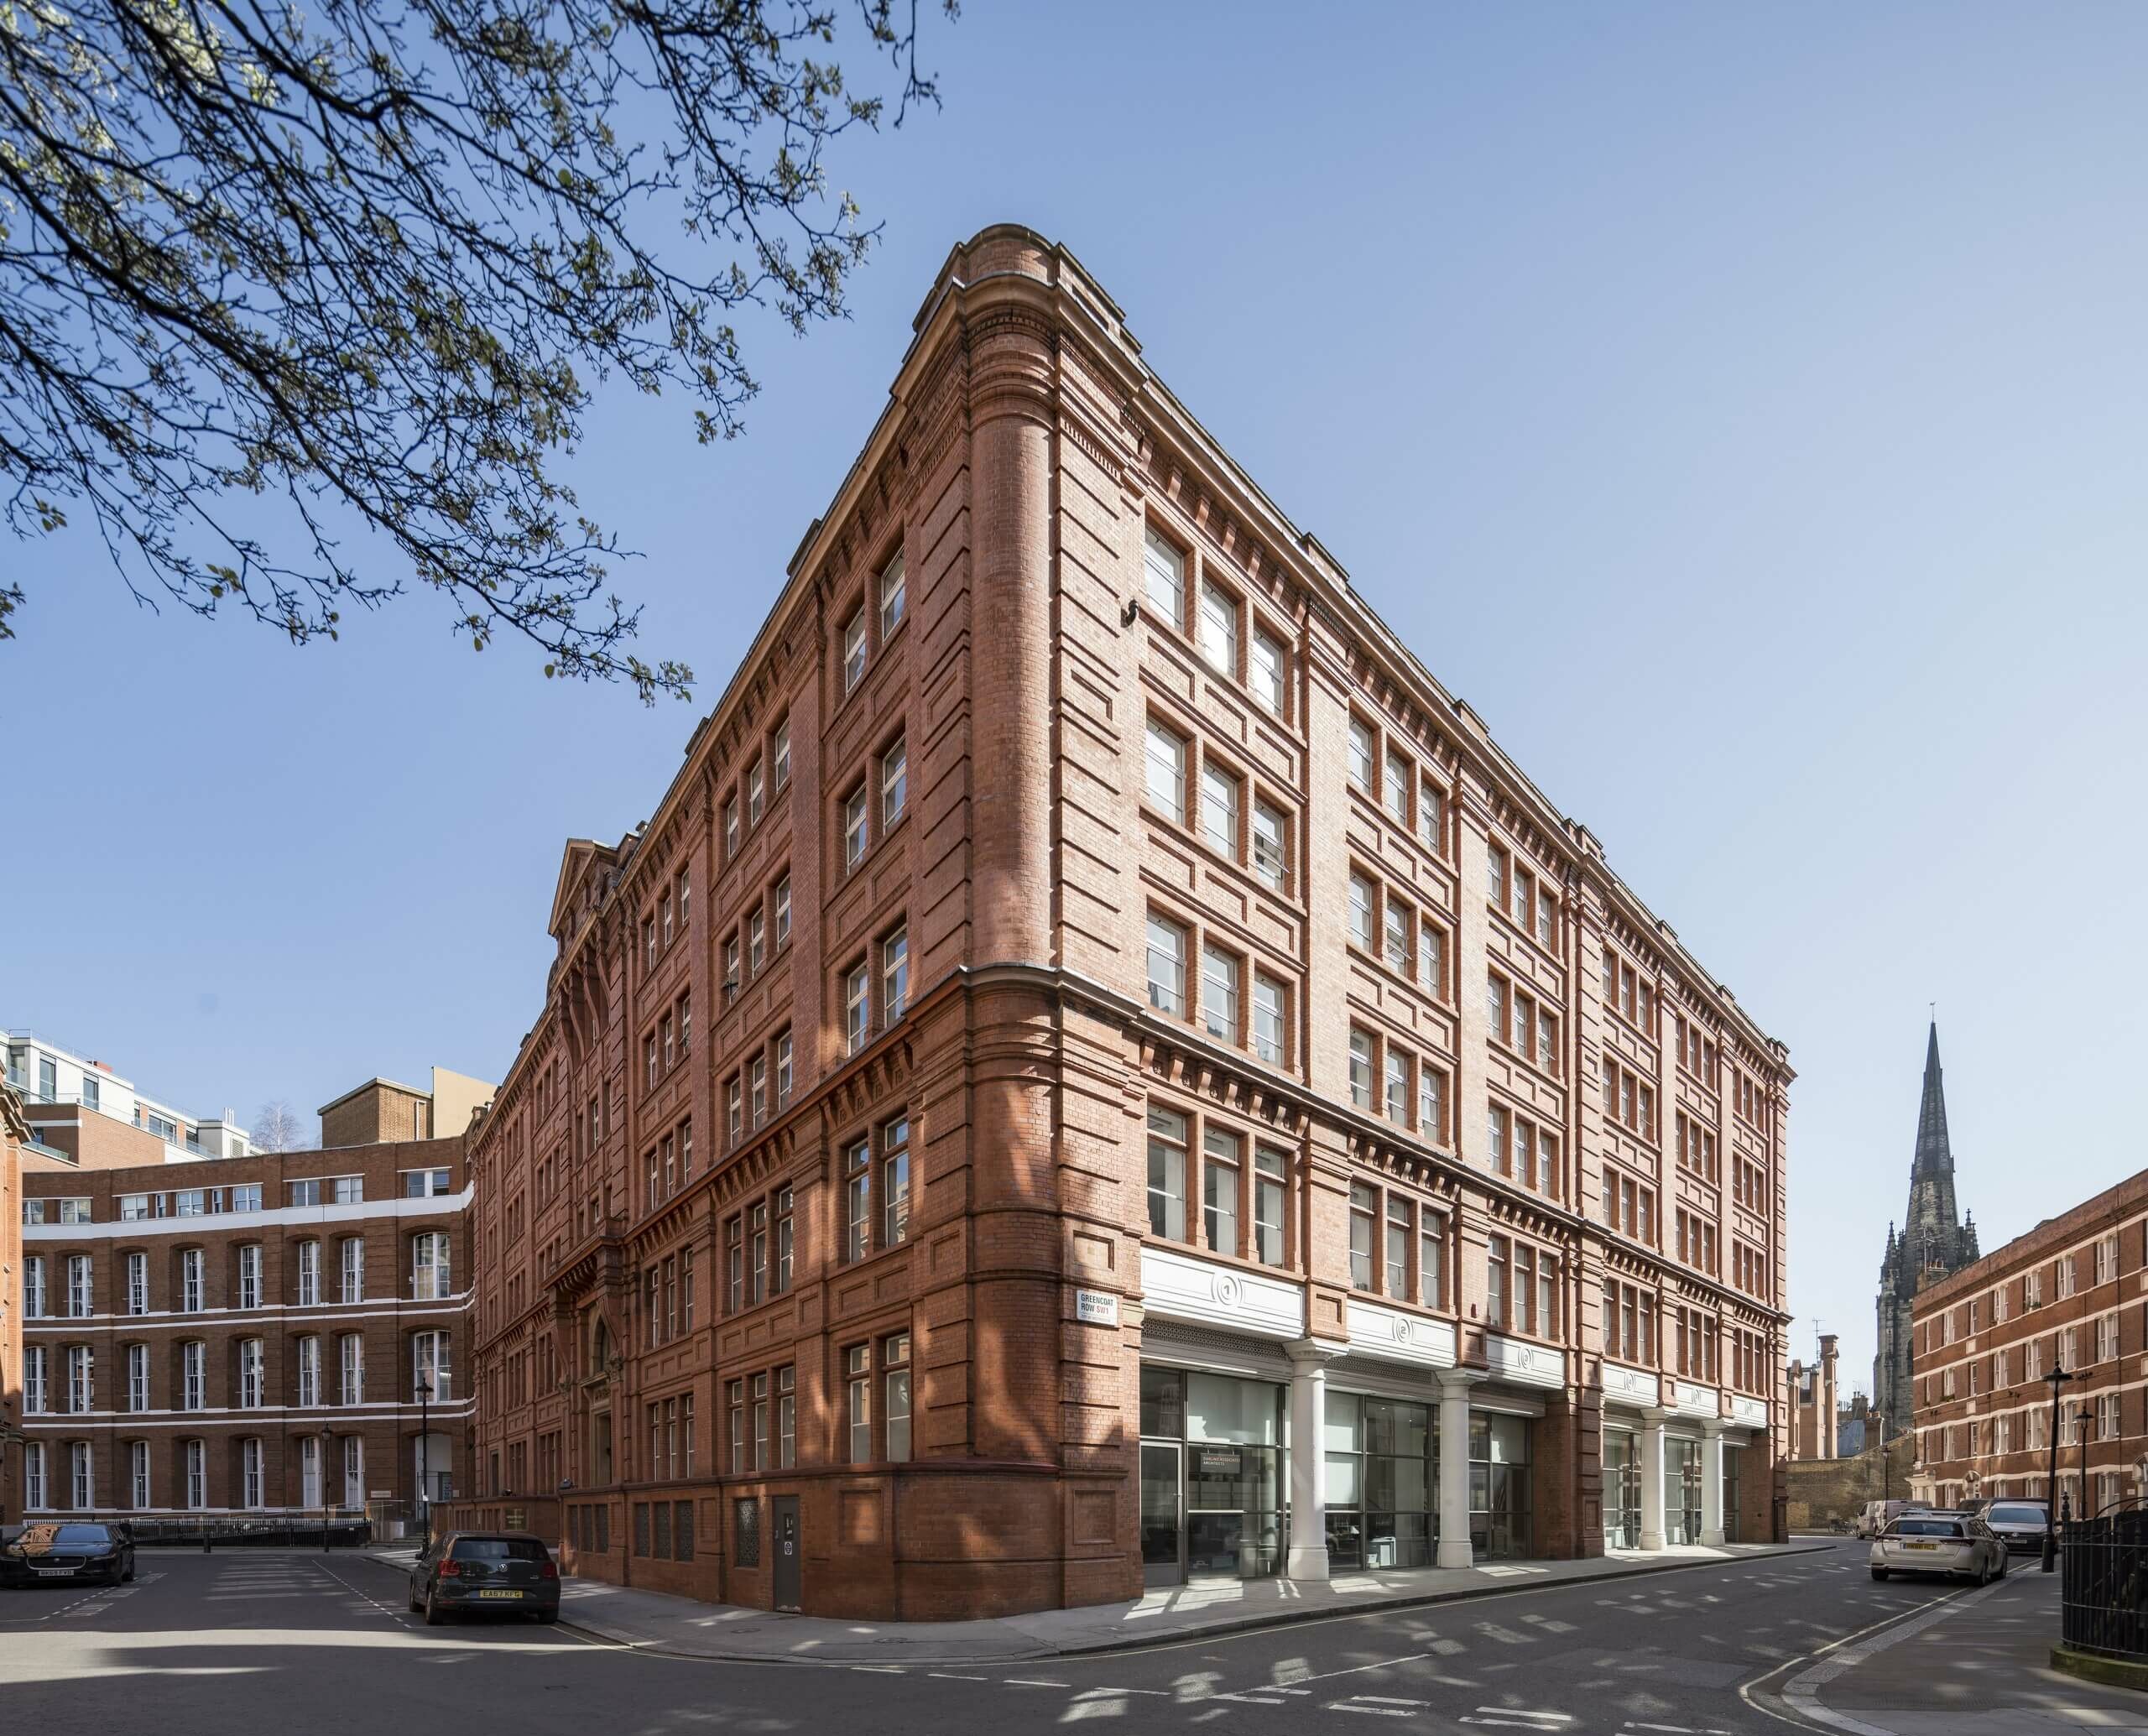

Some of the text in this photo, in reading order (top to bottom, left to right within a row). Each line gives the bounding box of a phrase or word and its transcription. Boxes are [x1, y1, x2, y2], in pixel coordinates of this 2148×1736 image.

[1223, 1284, 1230, 1295] 1
[1080, 1293, 1114, 1307] GREENCOAT
[1080, 1302, 1109, 1315] ROW SW1
